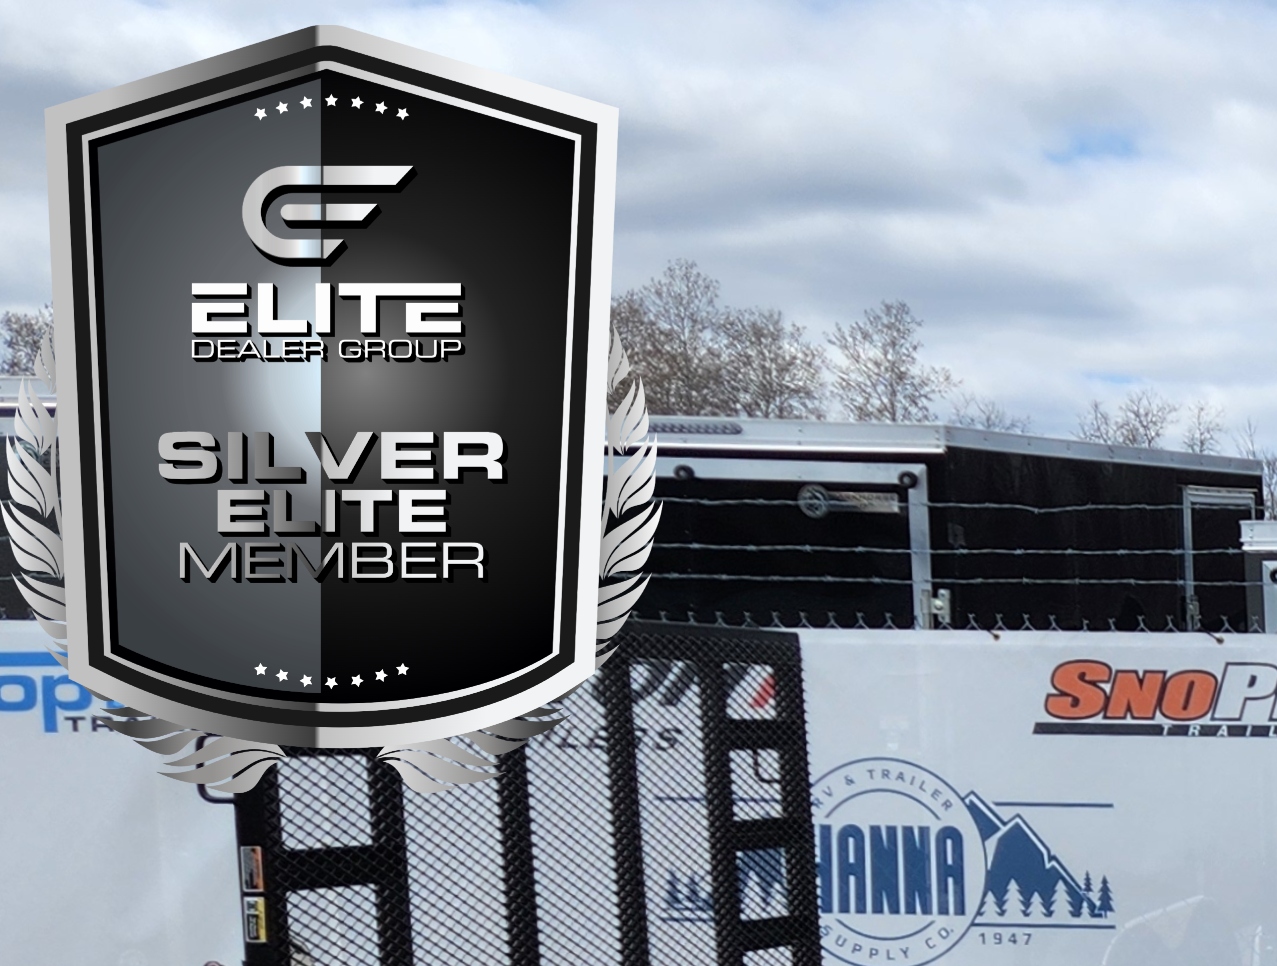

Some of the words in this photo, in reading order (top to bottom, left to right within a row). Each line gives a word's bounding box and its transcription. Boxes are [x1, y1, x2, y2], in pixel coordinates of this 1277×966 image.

[844, 774, 857, 787] &
[867, 768, 954, 812] TRAILER
[819, 924, 911, 961] SUPPLY
[924, 927, 955, 950] CO.
[978, 932, 1033, 946] 1947
